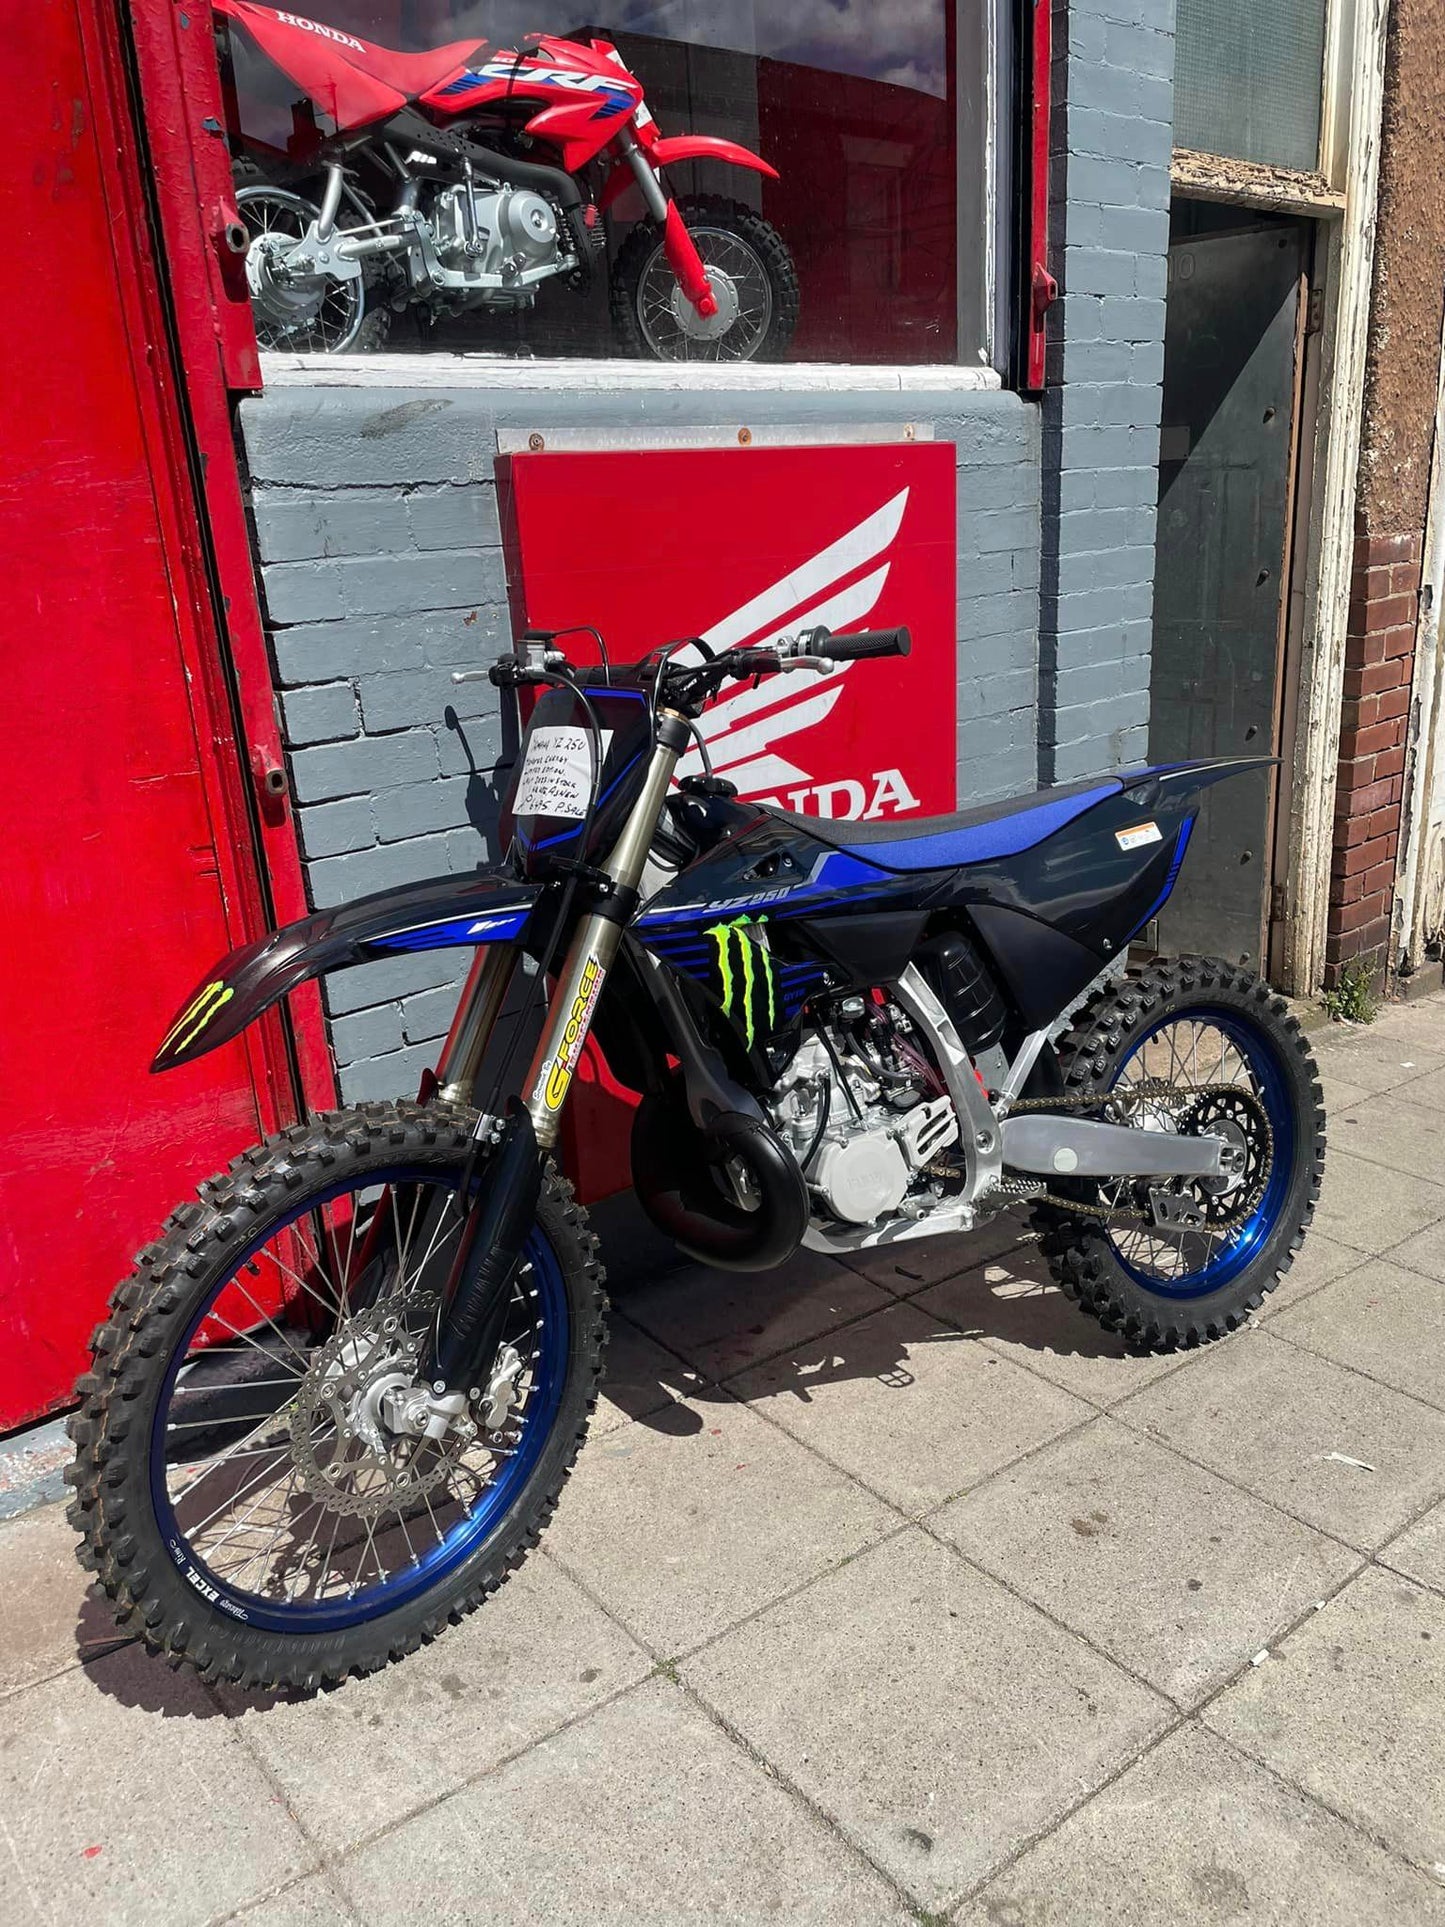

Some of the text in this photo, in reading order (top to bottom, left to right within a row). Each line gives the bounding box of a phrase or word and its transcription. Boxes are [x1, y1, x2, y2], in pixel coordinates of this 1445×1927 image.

[275, 9, 367, 54] HONDA
[478, 64, 638, 91] CRF
[564, 738, 586, 751] 250
[185, 1566, 220, 1602] EXCEL
